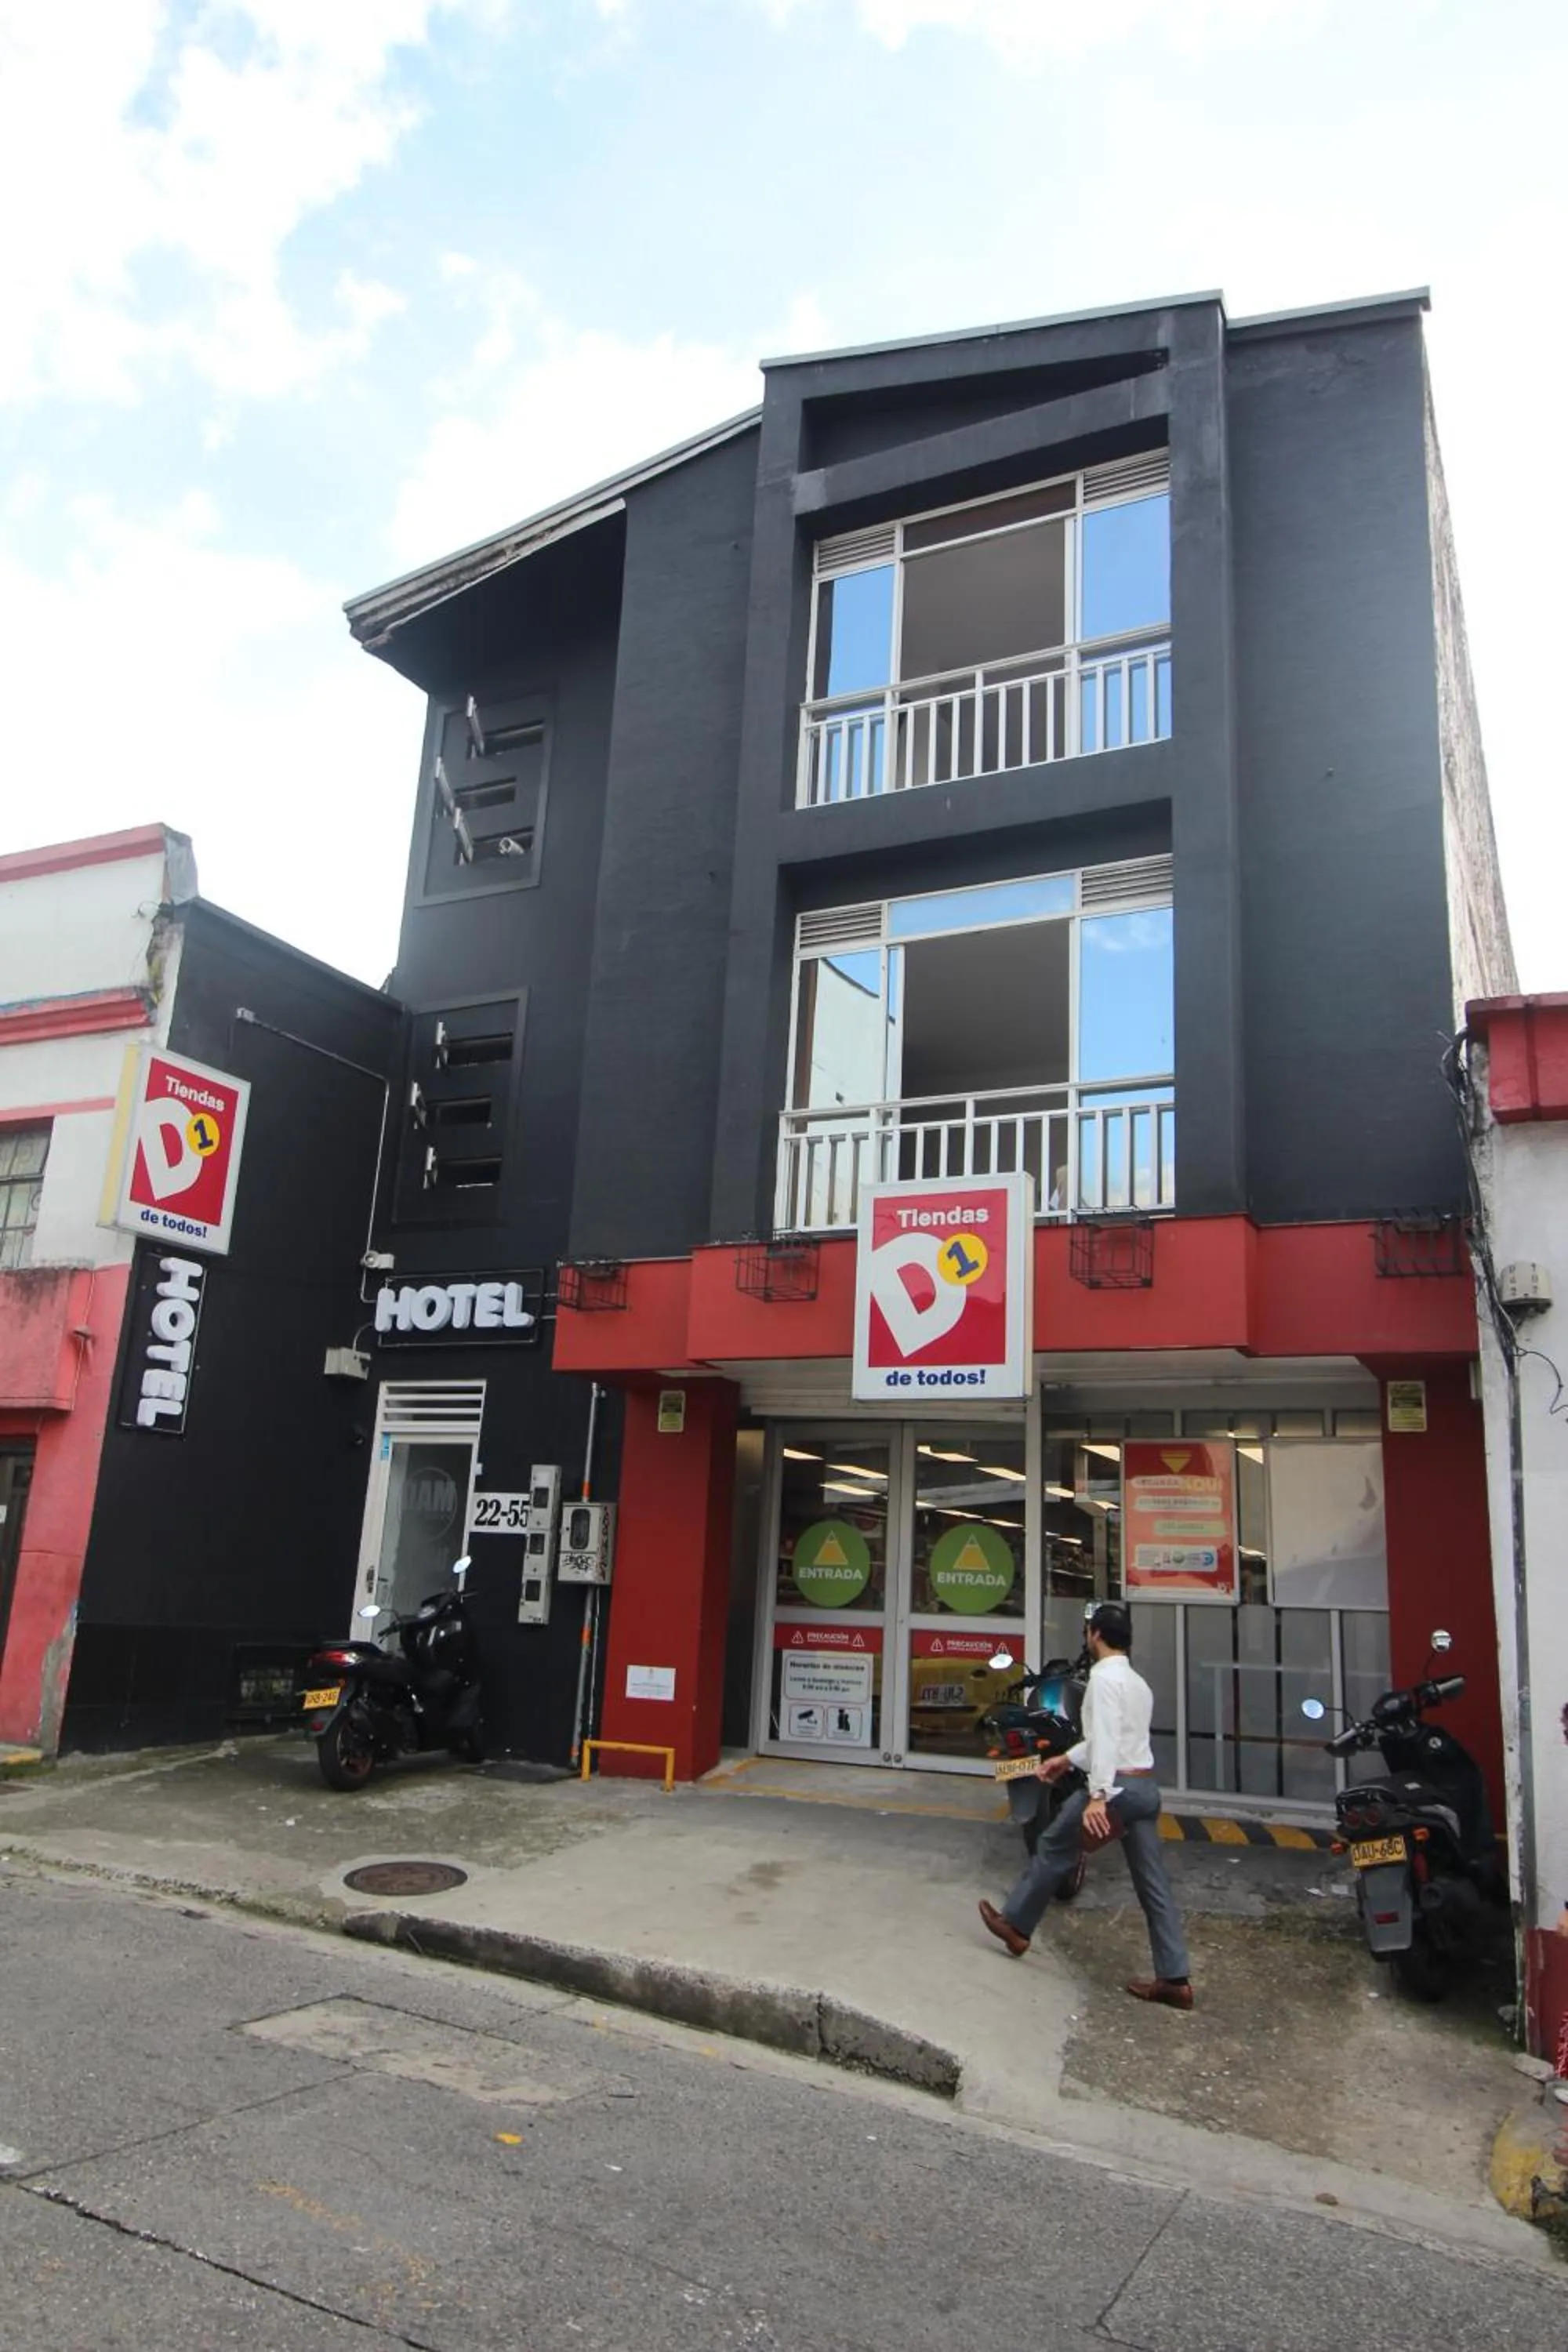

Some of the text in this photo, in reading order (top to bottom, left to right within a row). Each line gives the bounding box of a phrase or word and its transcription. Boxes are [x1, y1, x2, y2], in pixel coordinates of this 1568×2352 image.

[165, 1075, 226, 1112] Tiendas
[140, 1208, 209, 1239] de todos!
[897, 1207, 989, 1229] Tiendas
[375, 1282, 535, 1331] HOTEL
[136, 1257, 204, 1427] HOTEL
[886, 1370, 986, 1386] de todos!
[474, 1499, 530, 1528] 22-55
[799, 1568, 863, 1580] ENTRADA
[937, 1571, 1007, 1586] ENTRADA
